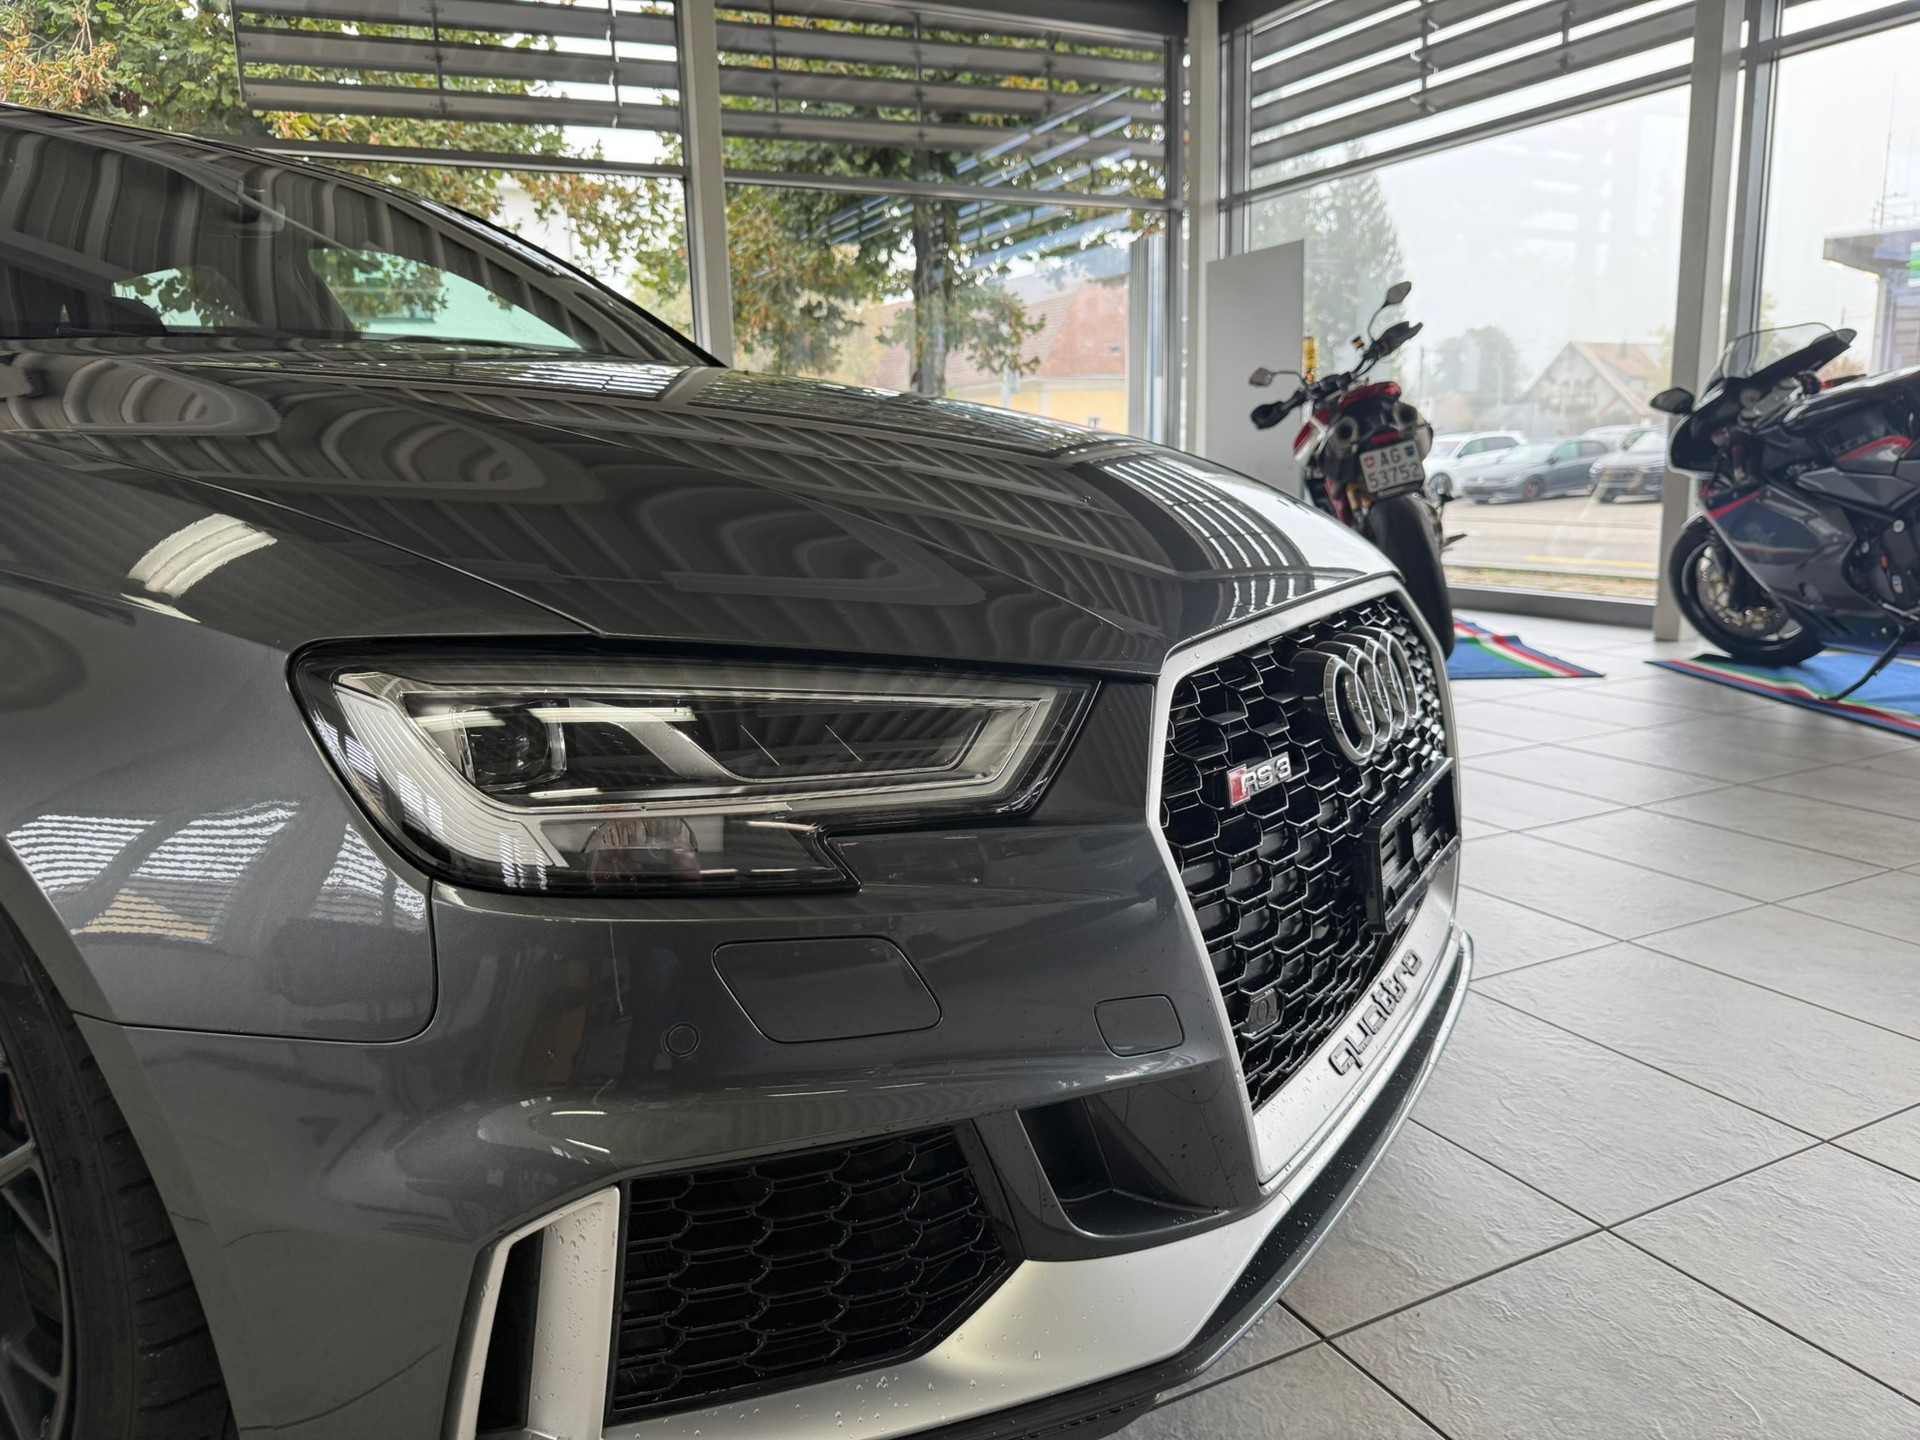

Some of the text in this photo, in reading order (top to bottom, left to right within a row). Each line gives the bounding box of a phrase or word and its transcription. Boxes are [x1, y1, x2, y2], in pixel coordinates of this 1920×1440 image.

[1380, 447, 1401, 467] AG
[1367, 462, 1419, 489] 53752
[1328, 948, 1423, 1077] quattro
